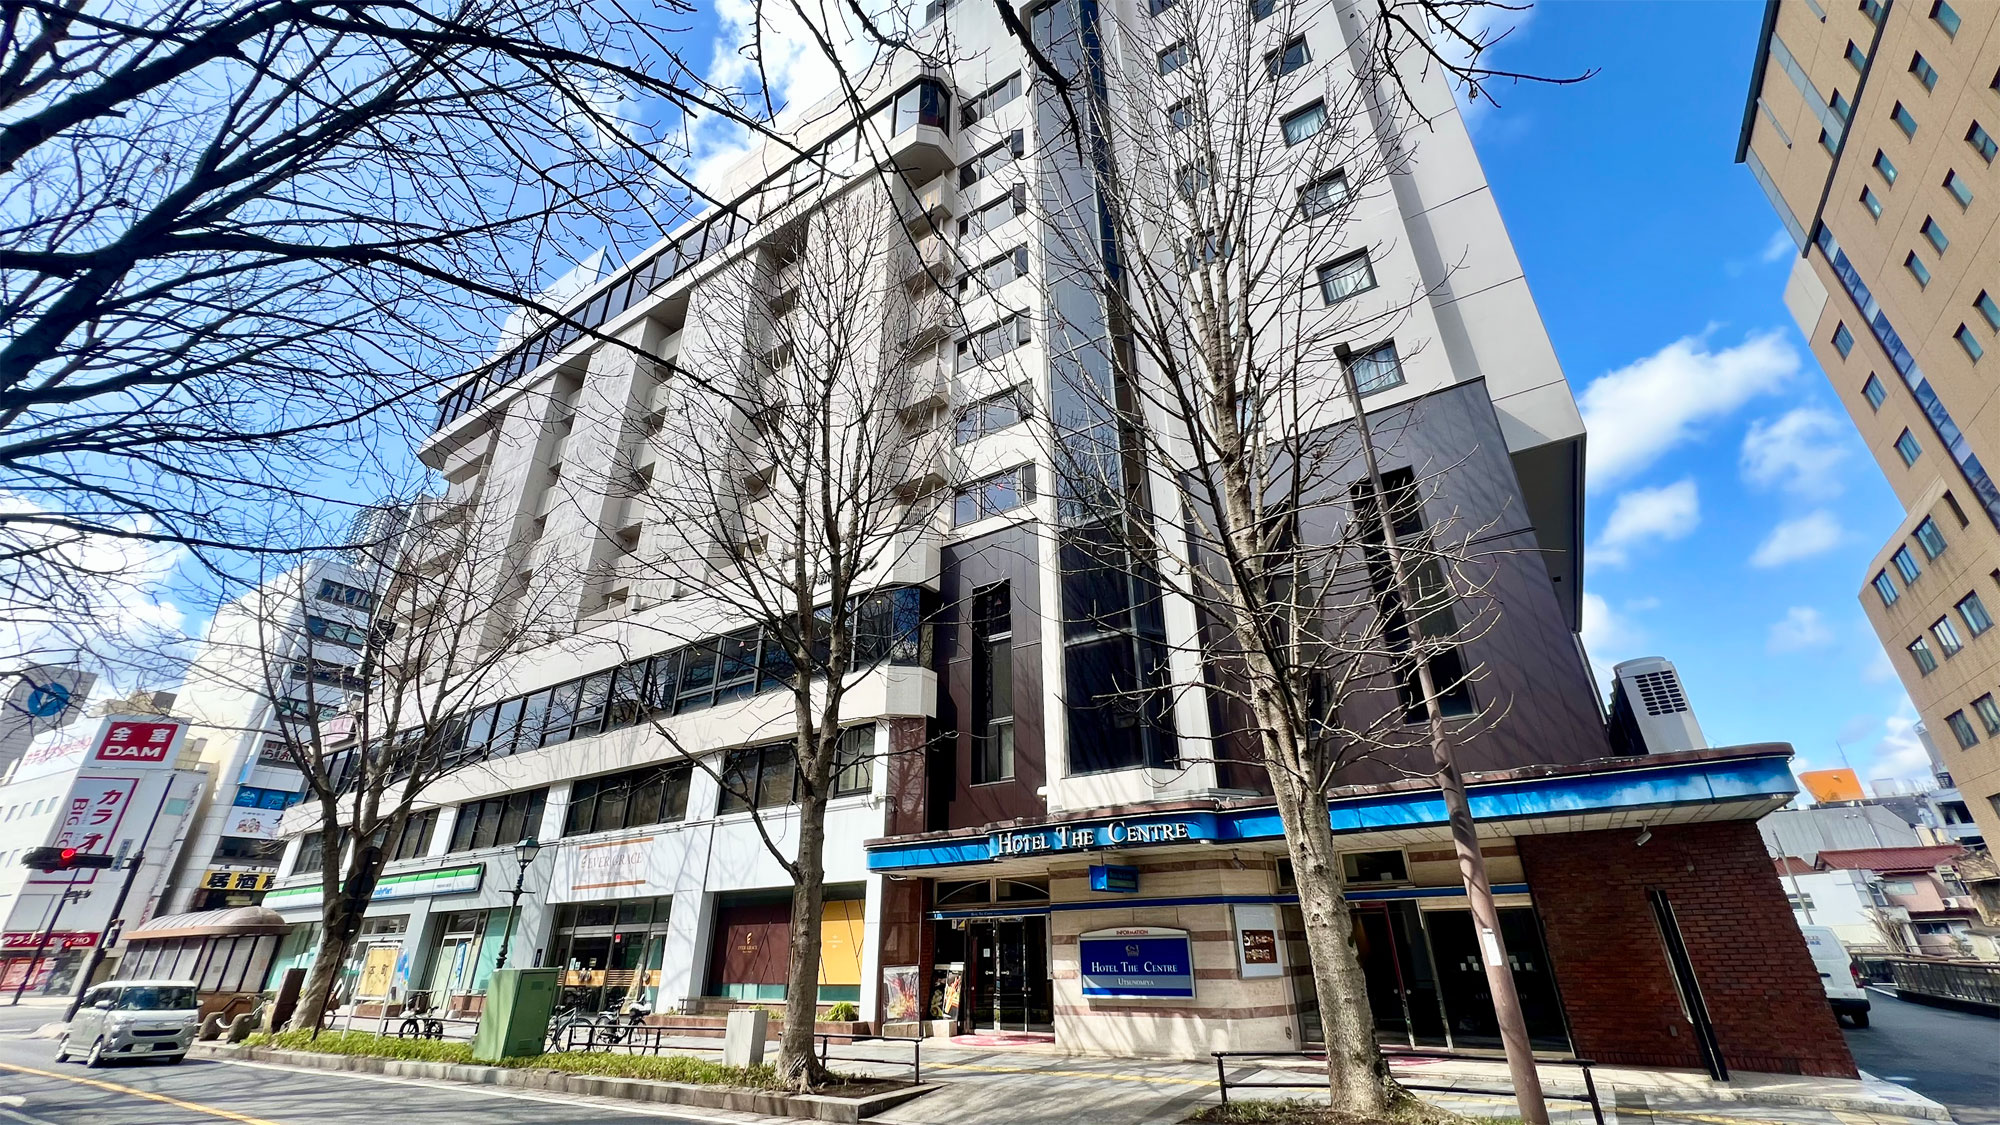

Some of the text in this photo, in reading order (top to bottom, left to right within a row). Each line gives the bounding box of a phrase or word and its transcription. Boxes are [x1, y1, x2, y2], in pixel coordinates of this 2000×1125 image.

[110, 726, 171, 743] 全室
[103, 745, 162, 757] DAM
[66, 798, 90, 826] BIG
[998, 821, 1188, 854] HOTEL THE CENTRE
[587, 851, 643, 869] EVER GRACE
[1091, 960, 1178, 973] HOTEL THE CENTRE
[1117, 978, 1155, 986] UTSUNOMIYA
